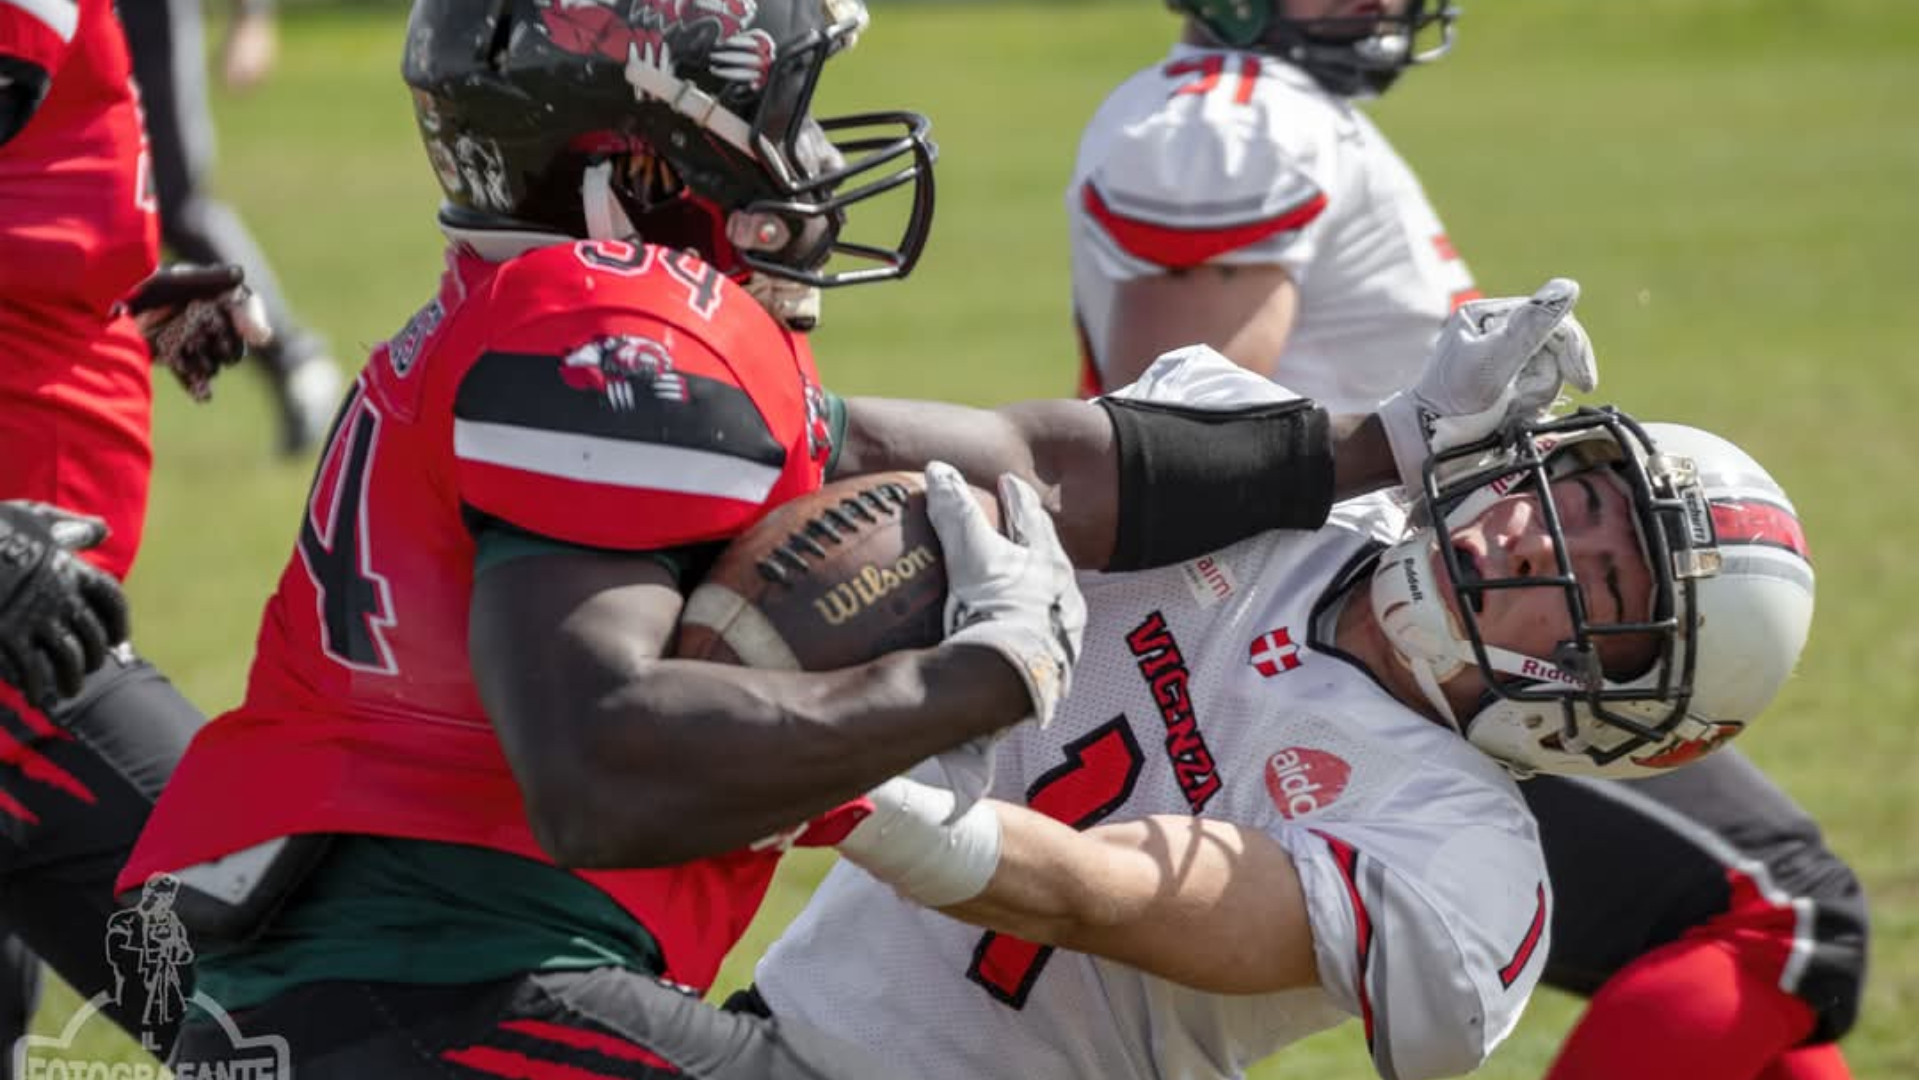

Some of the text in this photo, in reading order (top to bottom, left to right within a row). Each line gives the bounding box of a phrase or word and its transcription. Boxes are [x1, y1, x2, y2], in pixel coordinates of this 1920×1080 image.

[813, 545, 934, 625] Wilson
[1403, 558, 1423, 601] Riddell
[1272, 750, 1322, 816] aido
[1498, 881, 1546, 991] 1
